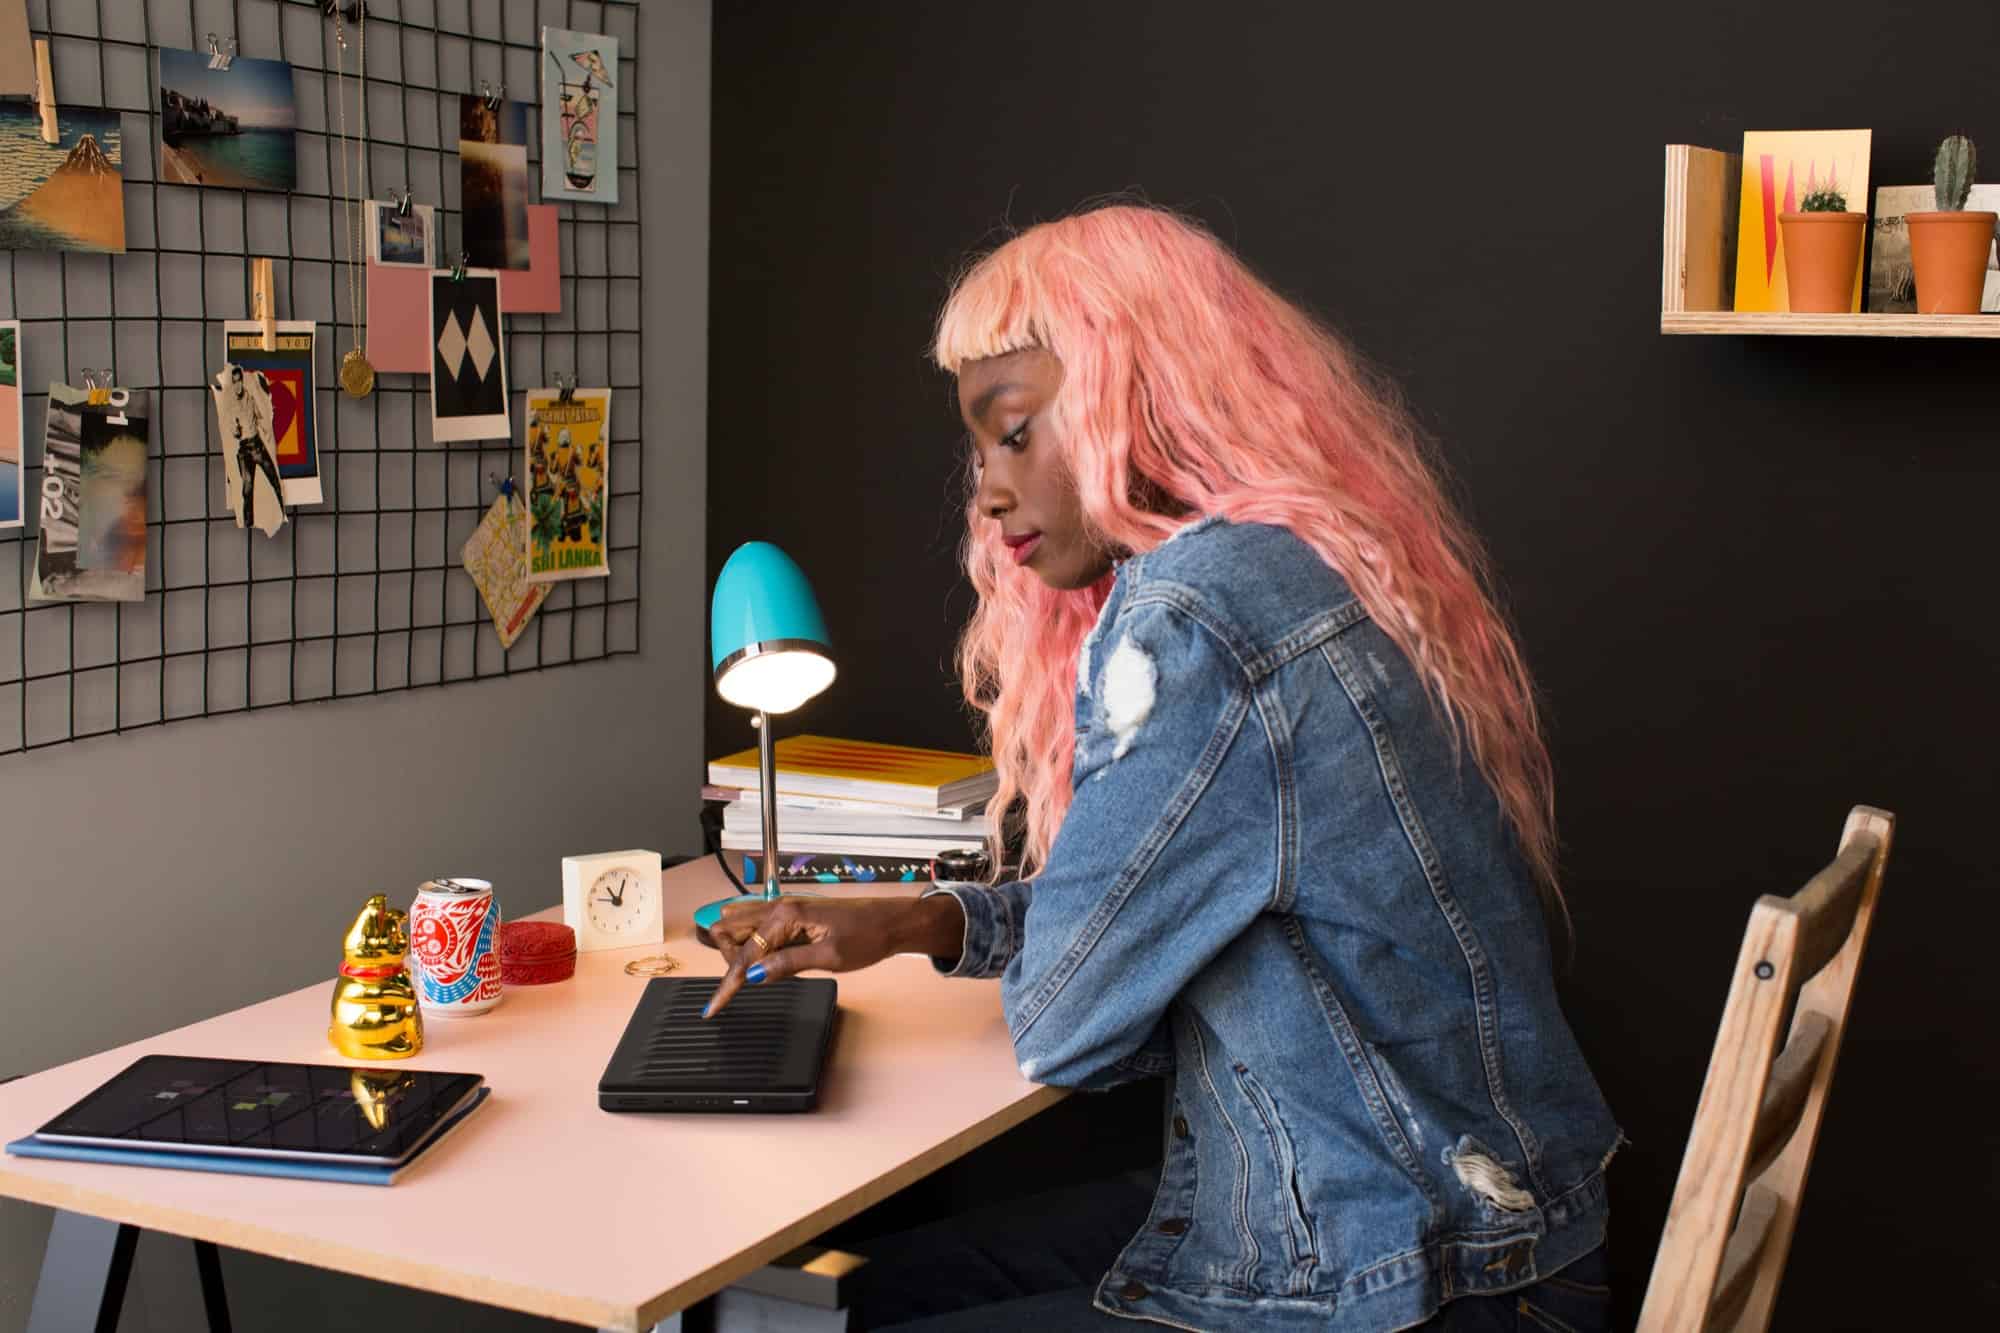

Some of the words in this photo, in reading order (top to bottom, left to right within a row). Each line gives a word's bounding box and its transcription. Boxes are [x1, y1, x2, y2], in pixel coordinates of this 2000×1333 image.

[107, 388, 129, 426] 01
[531, 552, 555, 573] SRI
[559, 549, 602, 568] LANKA
